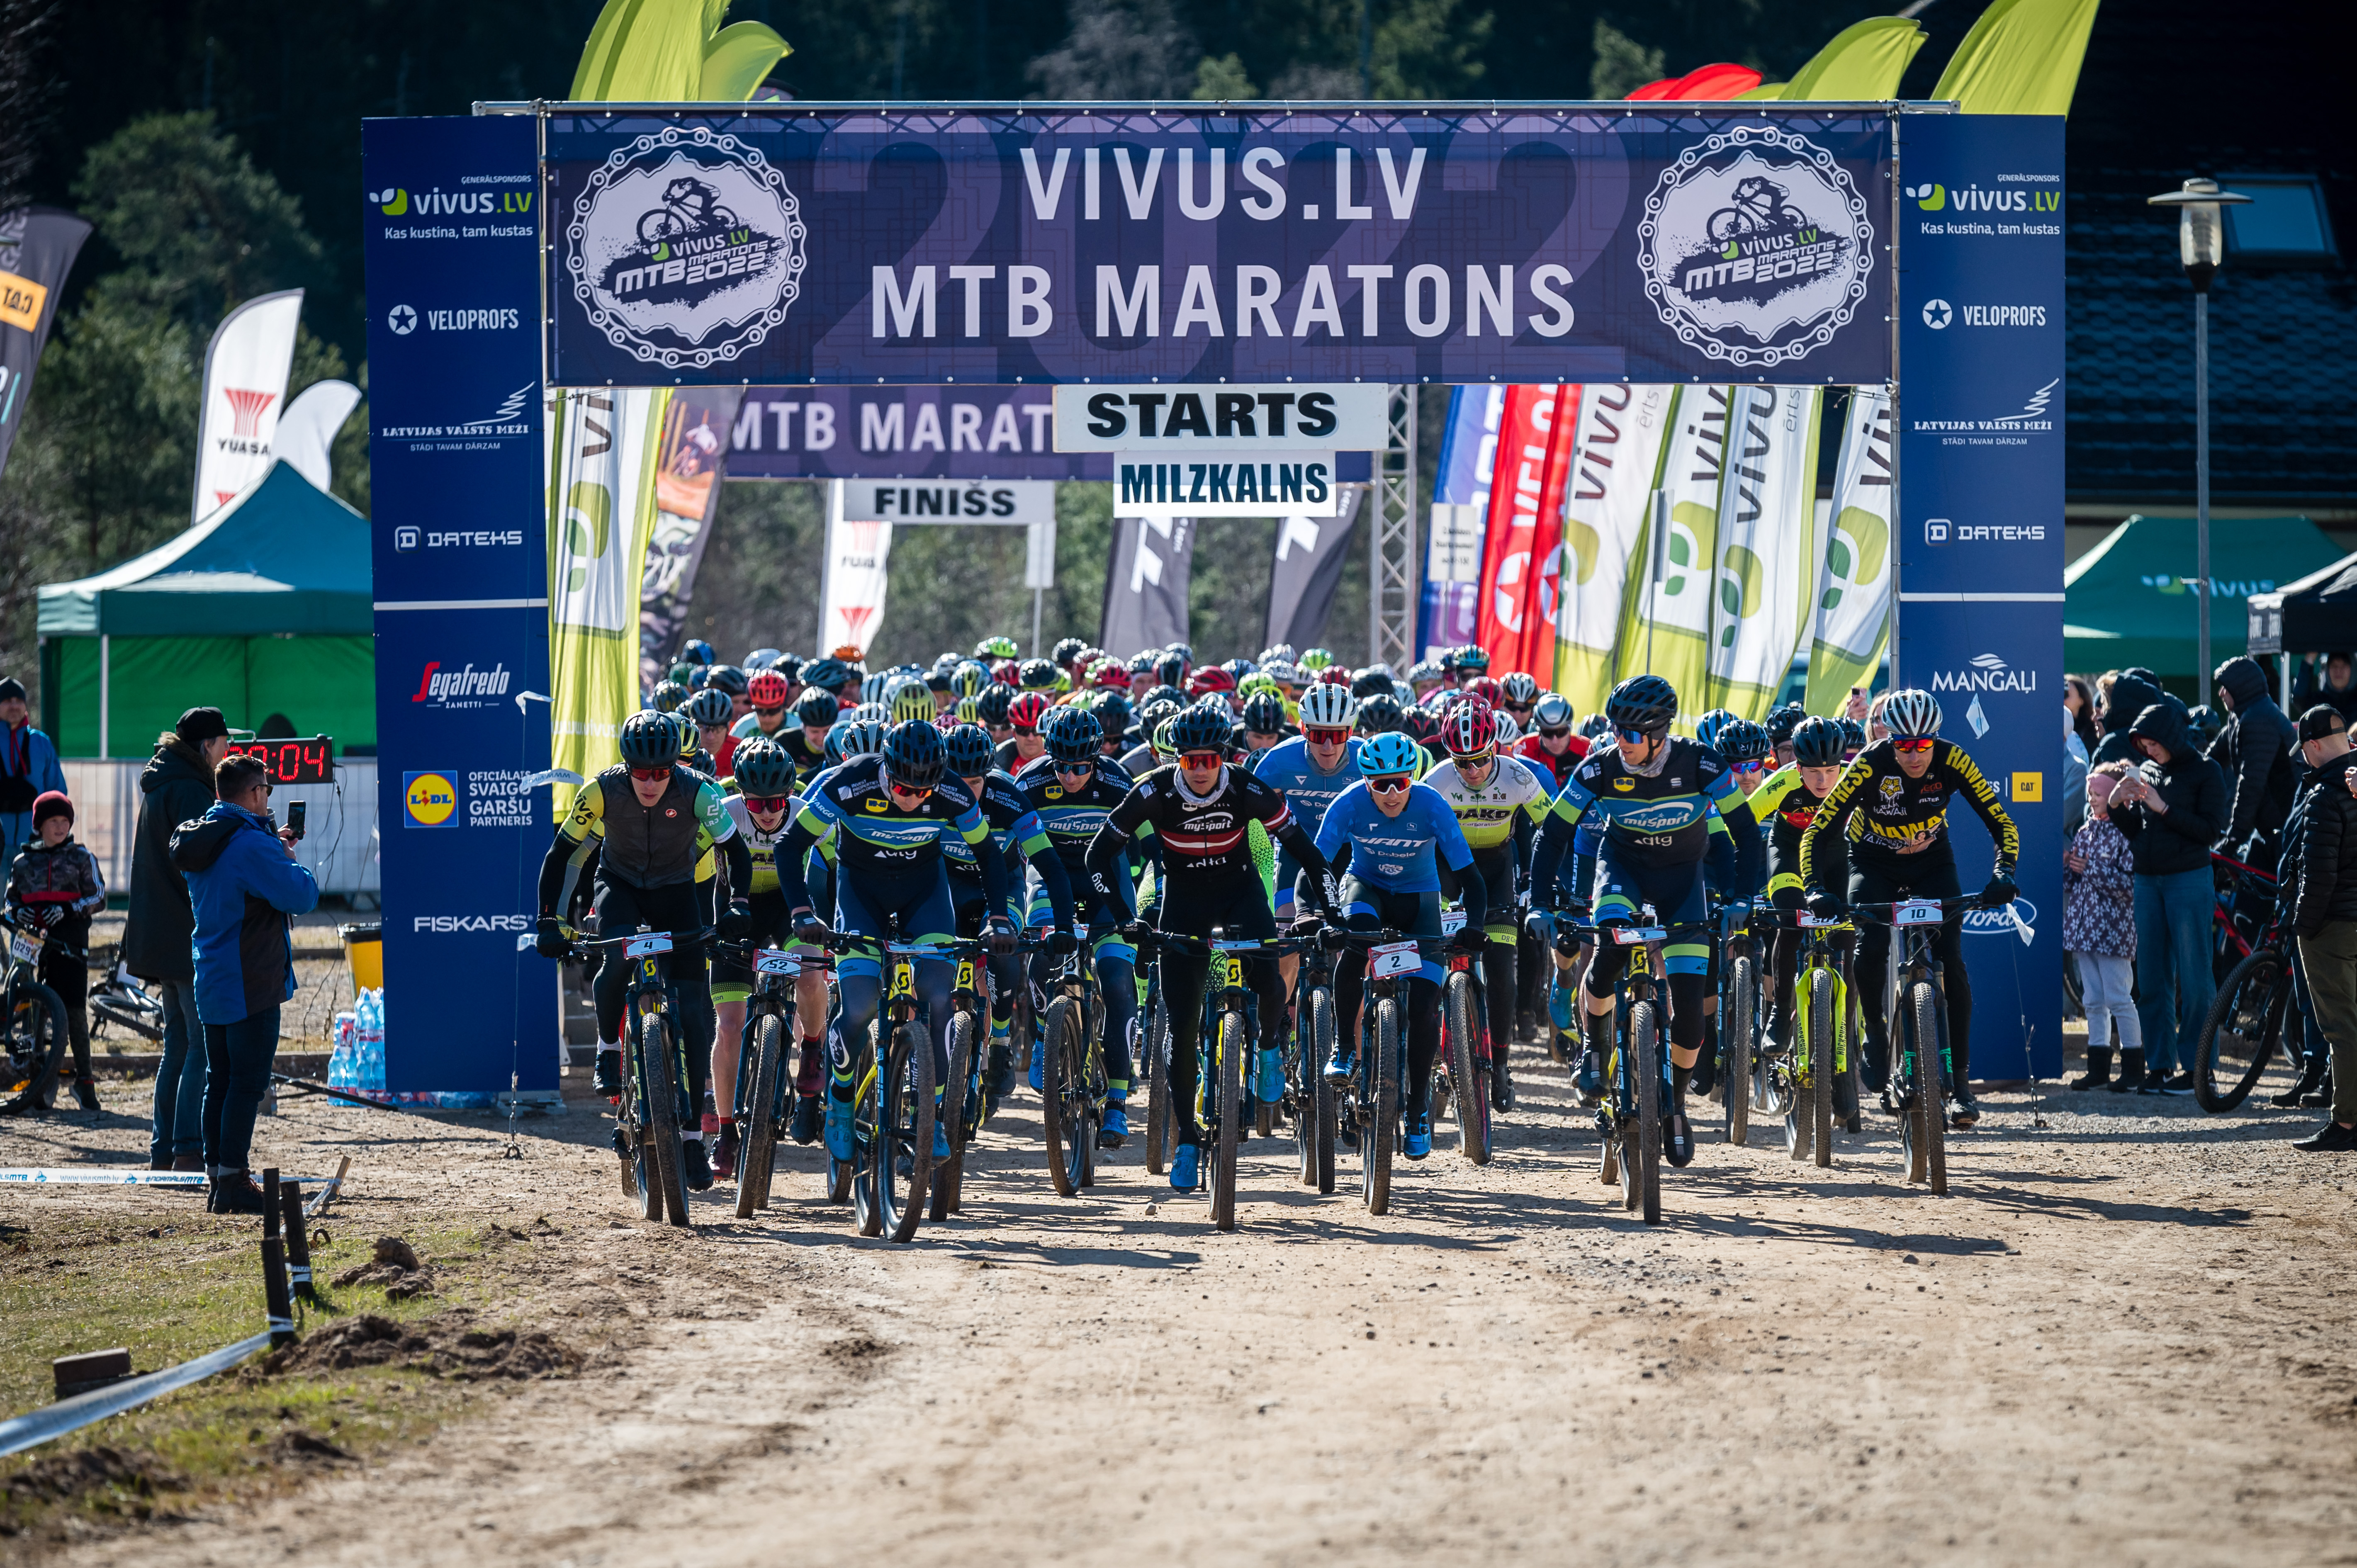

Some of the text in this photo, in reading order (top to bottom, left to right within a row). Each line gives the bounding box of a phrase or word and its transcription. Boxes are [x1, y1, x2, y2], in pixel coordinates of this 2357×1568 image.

[461, 175, 531, 185] ĢENERĀLSPONSORS
[1019, 147, 1428, 220] VIVUS.LV
[1997, 173, 2060, 182] ĢENERĀLSPONSORS
[385, 225, 533, 239] Kas kustina, tam kustas
[1922, 222, 2060, 236] Kas kustina, tam kustas
[688, 240, 769, 267] MARATONS
[1757, 239, 1836, 265] MARATONS
[615, 251, 766, 295] MTB 2022
[1685, 250, 1834, 292] MTB 2022
[871, 265, 1576, 338] MTB MARATONS
[428, 309, 519, 331] VELOPROFS
[1963, 306, 2046, 326] VELOPROFS
[1087, 392, 1338, 438] STARTS
[382, 423, 529, 437] LATVIJAS VALSTS MEŽI
[861, 402, 1053, 452] MARAT
[1914, 420, 2052, 430] LATVIJAS VALSTS MEŽI
[218, 438, 270, 457] YUASA
[410, 442, 500, 452] STĀDI TAVAM DĀRZAM
[1943, 437, 1965, 445] STĀDI
[1121, 463, 1328, 503] MILZKALNS
[875, 481, 1016, 517] FINIŠS
[427, 531, 523, 547] DATEKS
[1958, 525, 2045, 540] DATEKS
[412, 661, 511, 703] Segafredo
[1932, 671, 2036, 694] MANGAĻI
[469, 770, 531, 781] OFICIĀLAIS
[1946, 746, 1995, 803] HAWAII
[469, 782, 532, 797] SVAIGO
[854, 784, 881, 797] DEVELOPMEN
[940, 787, 968, 802] PROPERTIES
[941, 783, 958, 792] INVEST
[1815, 757, 1873, 830] EXPRESS
[2021, 782, 2035, 792] CAT
[469, 796, 531, 816] GARŠU
[939, 790, 970, 808] DEVELOPMENT
[994, 799, 1023, 813] DEVELOPMENT
[995, 794, 1021, 807] PROPERTIES
[813, 798, 835, 818] TARGO
[470, 815, 533, 827] PARTNERIS
[1868, 815, 1943, 840] HAWA
[1352, 836, 1430, 847] GIANT
[1911, 909, 1926, 919] 10
[414, 915, 528, 933] FISKARS
[1445, 922, 1459, 932] 17
[14, 941, 31, 956] 029
[644, 941, 653, 950] 4
[768, 960, 788, 971] 52
[1391, 955, 1401, 968] 2
[60, 1174, 119, 1183] www.vivusmtb.lv
